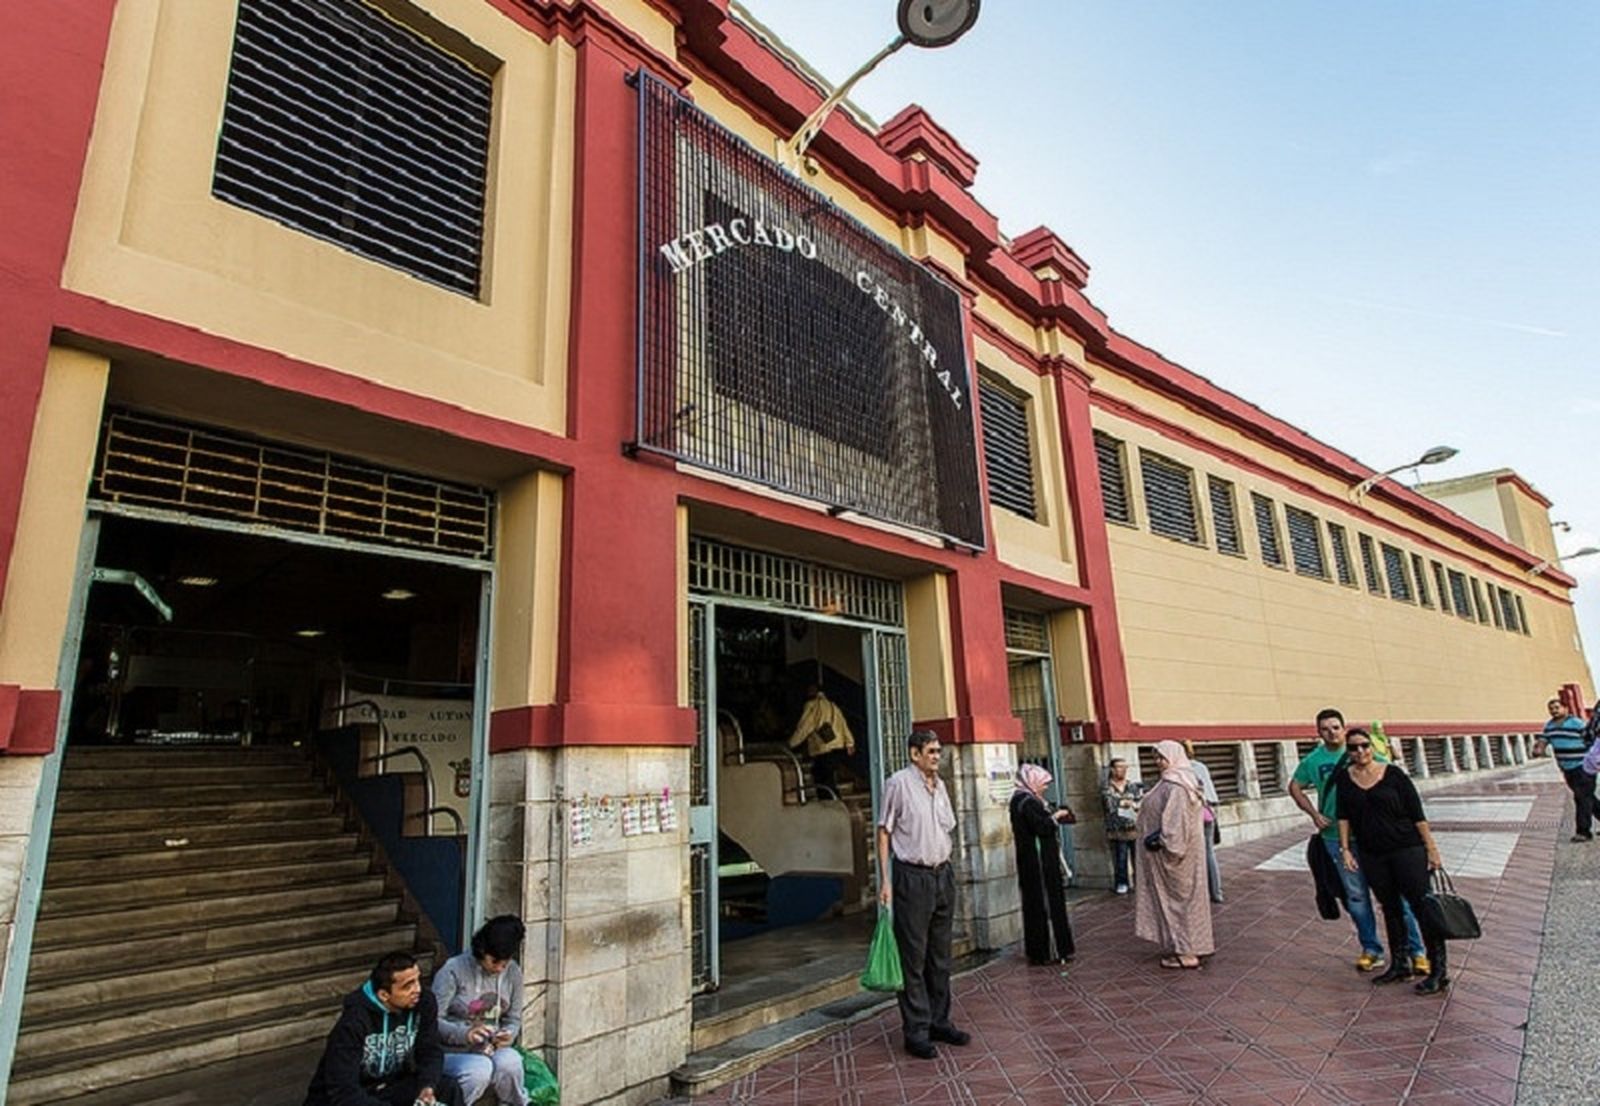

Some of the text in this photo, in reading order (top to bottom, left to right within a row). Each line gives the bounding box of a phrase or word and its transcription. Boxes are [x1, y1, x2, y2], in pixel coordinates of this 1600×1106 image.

[660, 218, 964, 411] MERCADO CENTRAL
[391, 732, 458, 744] MERCADO
